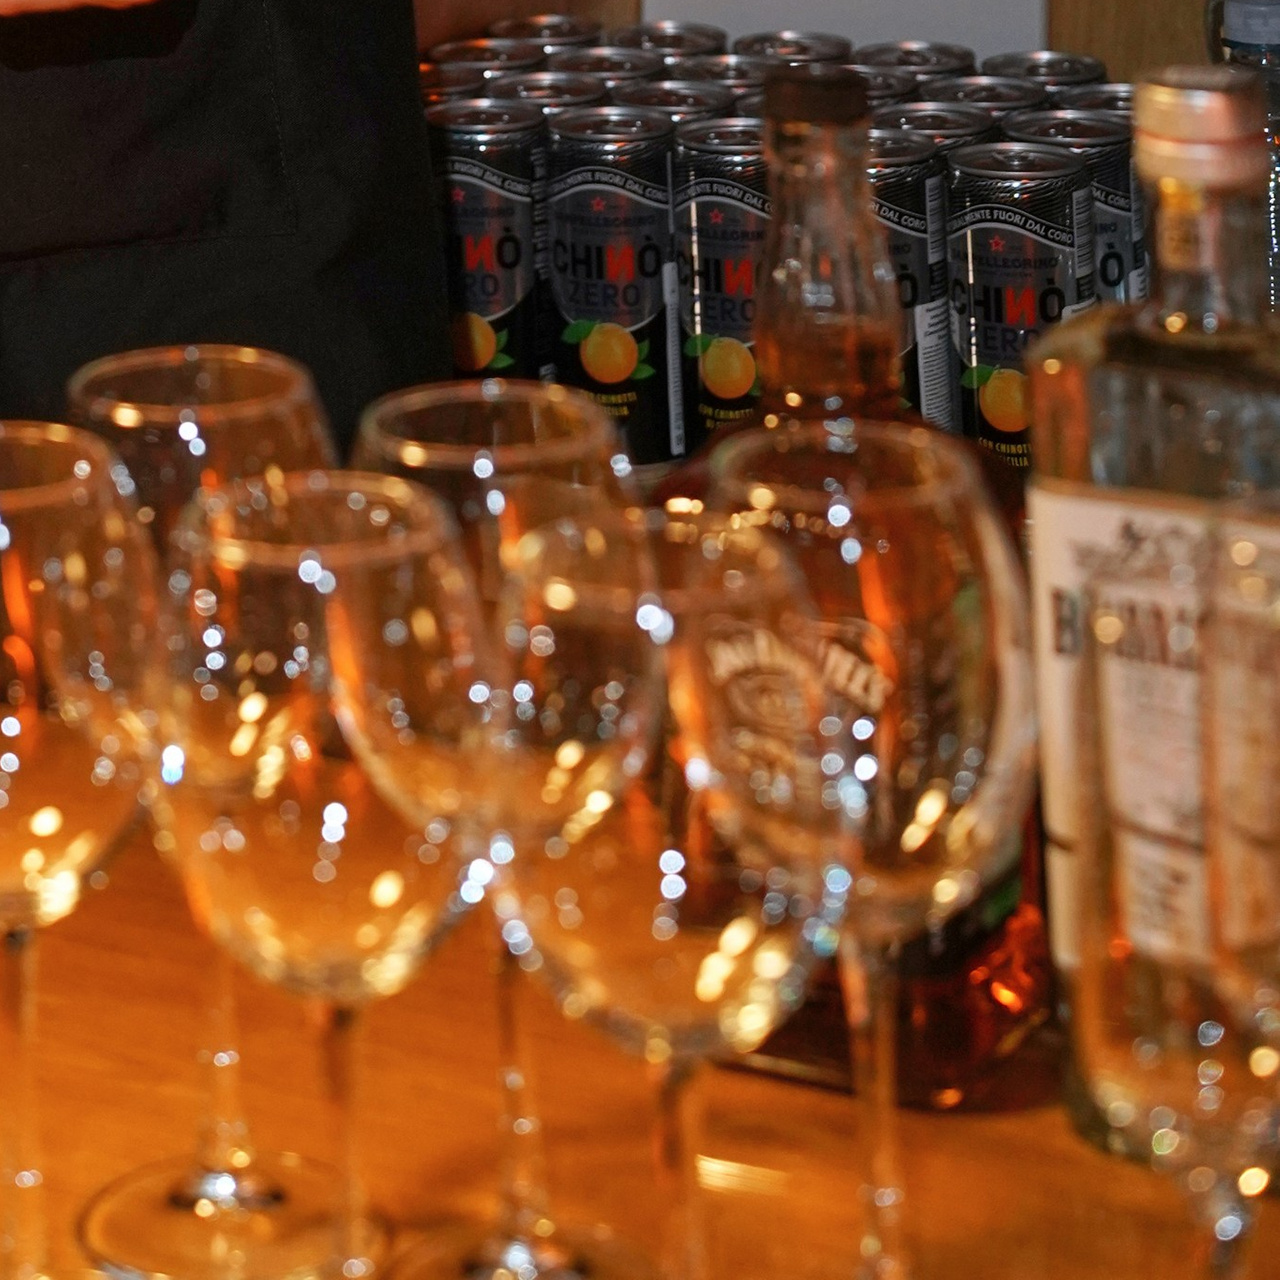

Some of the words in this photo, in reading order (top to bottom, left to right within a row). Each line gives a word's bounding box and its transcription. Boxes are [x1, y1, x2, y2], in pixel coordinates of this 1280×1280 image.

[880, 206, 900, 221] DAL
[993, 209, 1026, 226] FUORI
[1026, 219, 1046, 237] DAL
[1047, 229, 1073, 244] CORO
[569, 280, 641, 307] ZERO
